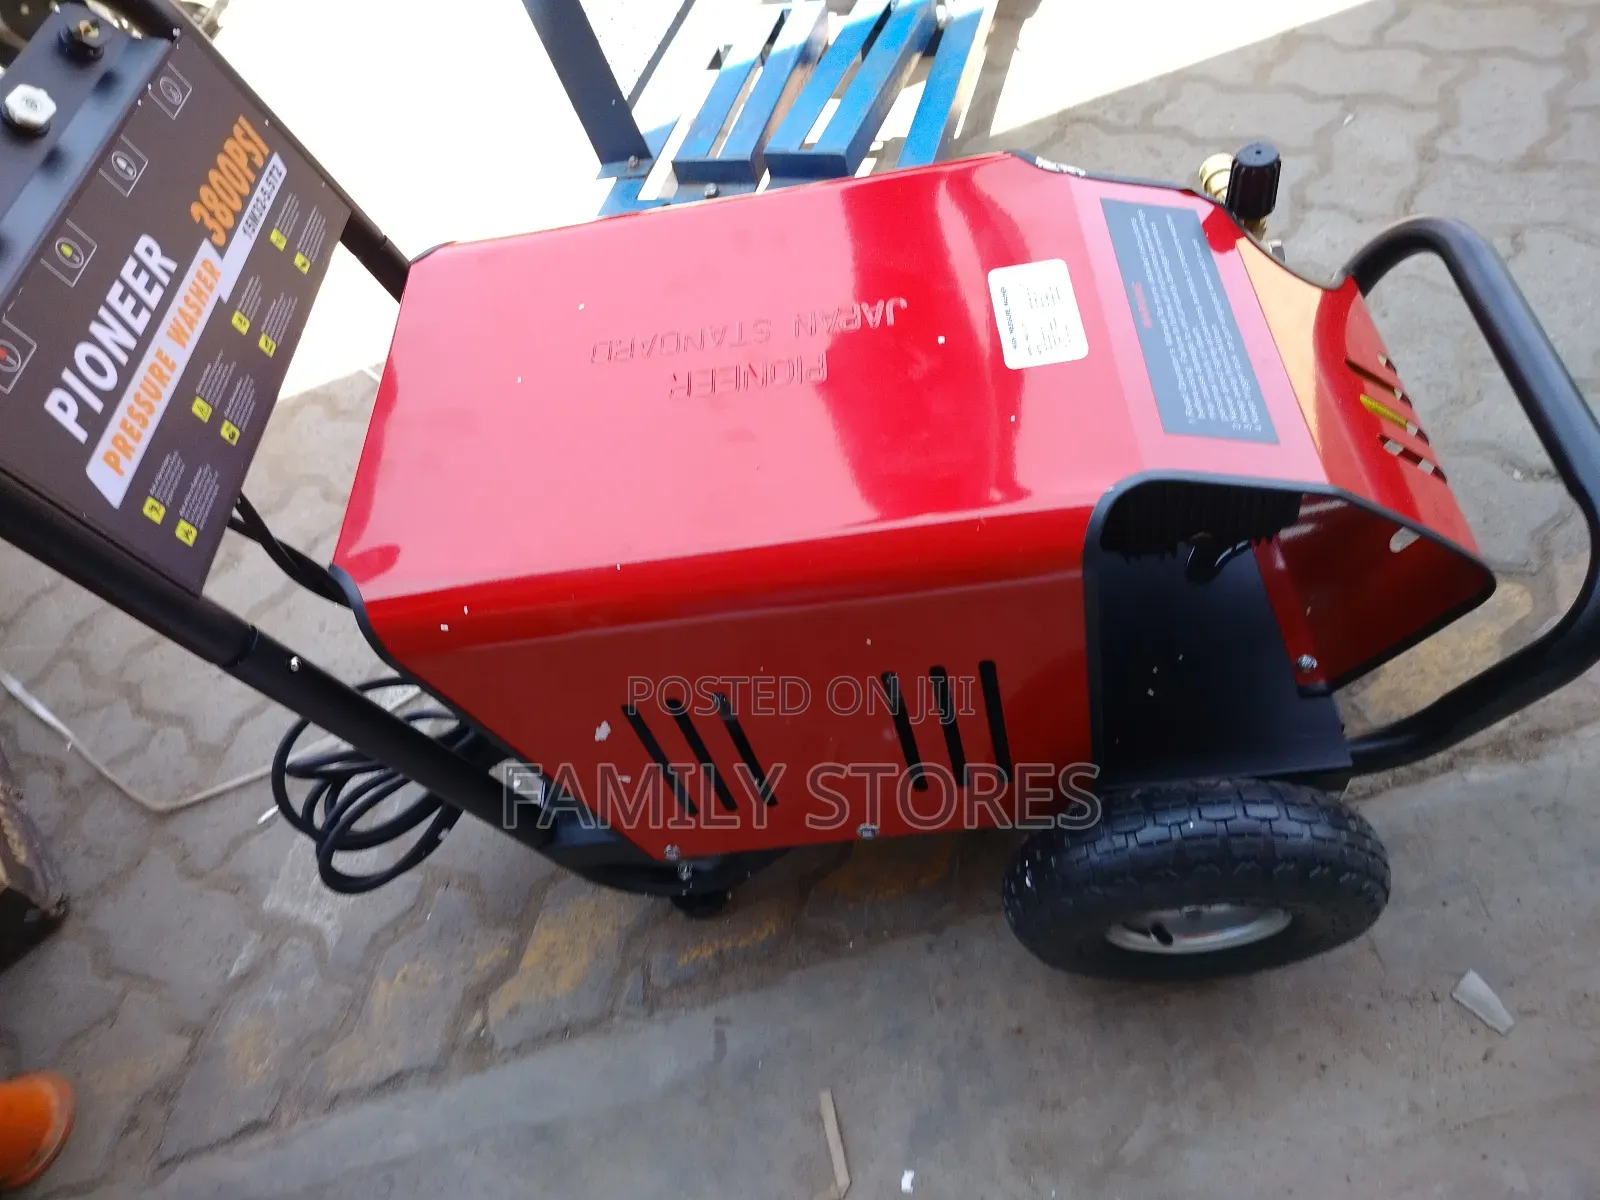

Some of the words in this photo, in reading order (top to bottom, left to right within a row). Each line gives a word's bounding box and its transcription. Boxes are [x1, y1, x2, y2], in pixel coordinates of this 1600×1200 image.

[191, 115, 269, 247] 3800PSI
[44, 234, 178, 443] PIONEER
[591, 319, 771, 364] STANDARD
[793, 297, 907, 339] JAPAN
[103, 349, 177, 477] PRESSURE
[168, 258, 222, 355] WASHER
[669, 351, 829, 398] PIONEER
